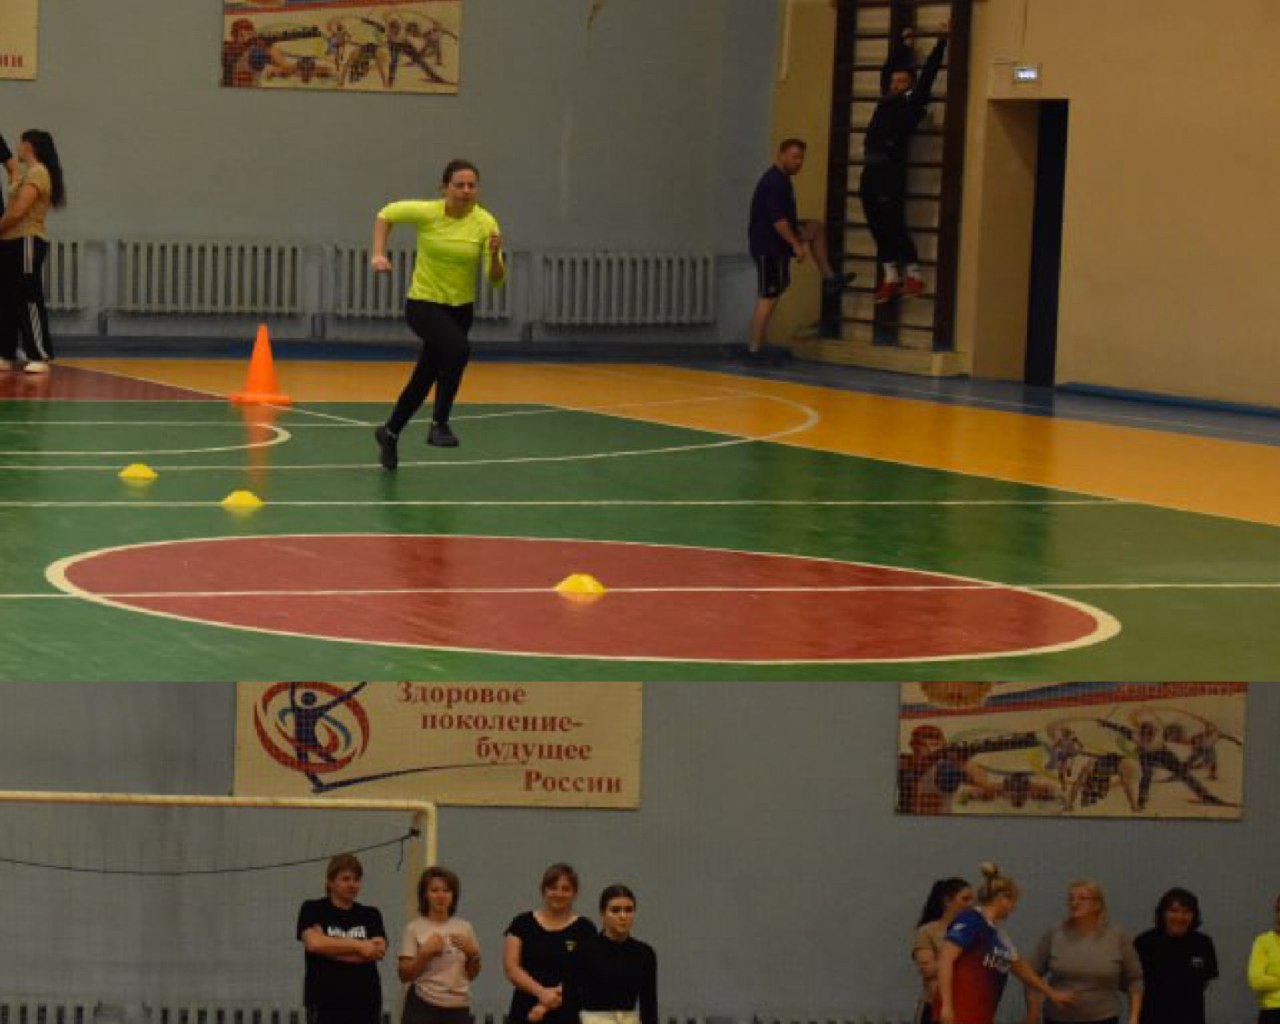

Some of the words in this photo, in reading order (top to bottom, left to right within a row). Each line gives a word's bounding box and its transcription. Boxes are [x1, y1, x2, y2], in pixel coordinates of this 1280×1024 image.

[397, 682, 526, 708] Здоровое
[421, 711, 583, 732] поколение-
[476, 736, 592, 765] будущее
[524, 769, 622, 794] России
